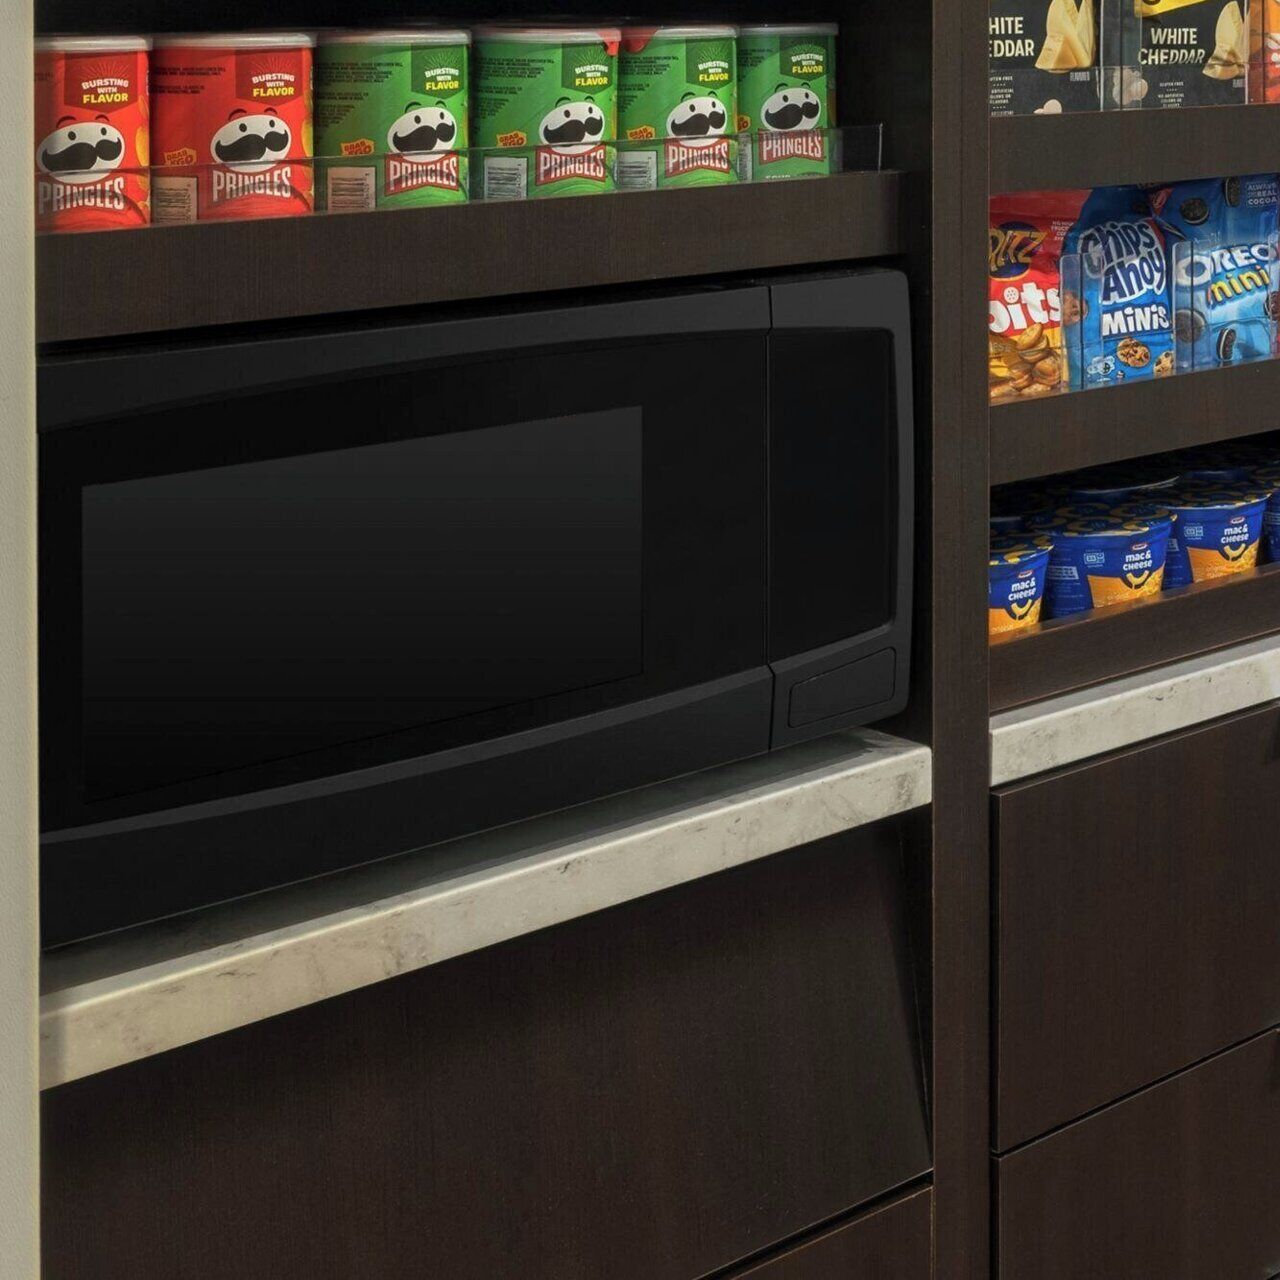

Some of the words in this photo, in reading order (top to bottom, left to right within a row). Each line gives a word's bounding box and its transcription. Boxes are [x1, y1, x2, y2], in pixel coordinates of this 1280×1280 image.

[1150, 27, 1198, 46] WHITE
[791, 53, 824, 63] BURSTING
[1137, 47, 1206, 66] CHEDDAR
[575, 65, 609, 75] BURSTING
[698, 61, 729, 71] BURSTING
[792, 65, 824, 74] FLAVOR
[252, 72, 295, 84] BURSTING
[425, 68, 460, 78] BURSTING
[699, 72, 729, 83] FLAVOR
[81, 77, 129, 90] BURSTING
[425, 81, 460, 91] FLAVOR
[575, 76, 609, 87] FLAVOR
[97, 86, 118, 94] WITH
[252, 86, 294, 98] FLAVOR
[82, 93, 129, 104] FLAVOR
[762, 131, 823, 160] PRINGLES
[668, 142, 728, 170] PRINGLES
[539, 149, 605, 179] PRINGLES
[388, 156, 458, 191] PRINGLES
[212, 165, 292, 203] PRINGLES
[38, 176, 126, 215] PRINGLES
[1078, 222, 1155, 278] Chips
[1175, 243, 1277, 288] OREO
[1100, 249, 1167, 305] Ahoy
